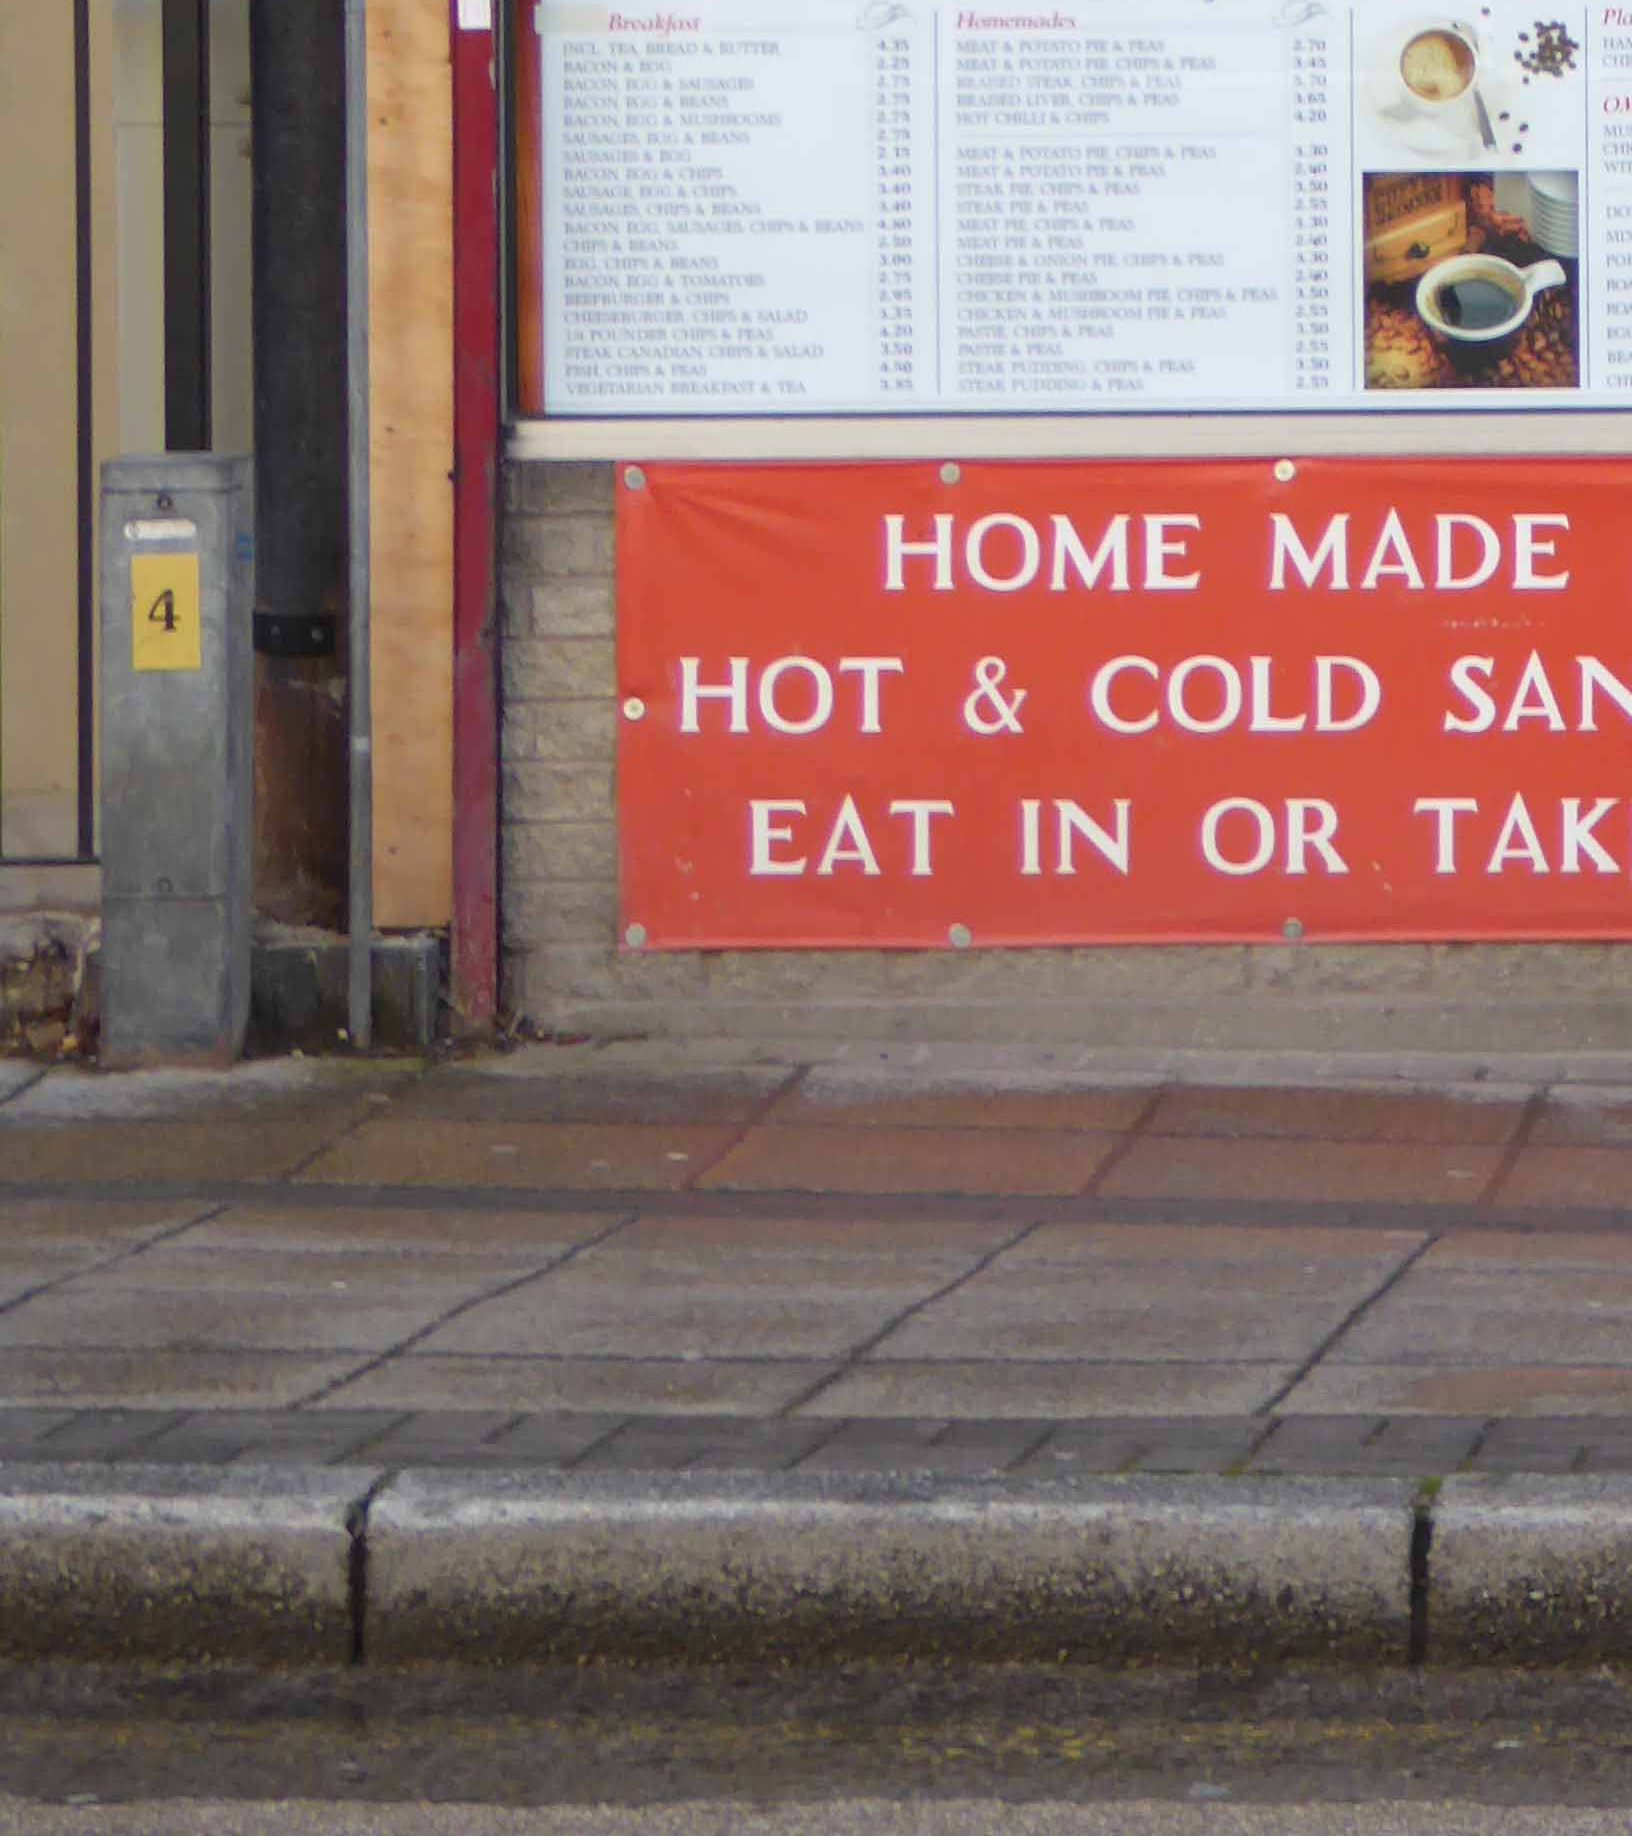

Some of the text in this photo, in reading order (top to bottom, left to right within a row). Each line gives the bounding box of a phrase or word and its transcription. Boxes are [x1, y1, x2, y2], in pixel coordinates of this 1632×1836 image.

[608, 14, 700, 37] Breakfast
[956, 12, 1076, 29] Homemades
[884, 513, 1201, 592] HOME
[1269, 507, 1570, 591] MADE
[148, 588, 181, 631] 4
[680, 655, 905, 735] HOT
[963, 655, 1028, 735] &
[1090, 654, 1382, 735] COLD
[749, 795, 955, 876] EAT
[1021, 799, 1131, 877] IN
[1201, 797, 1350, 876] OR
